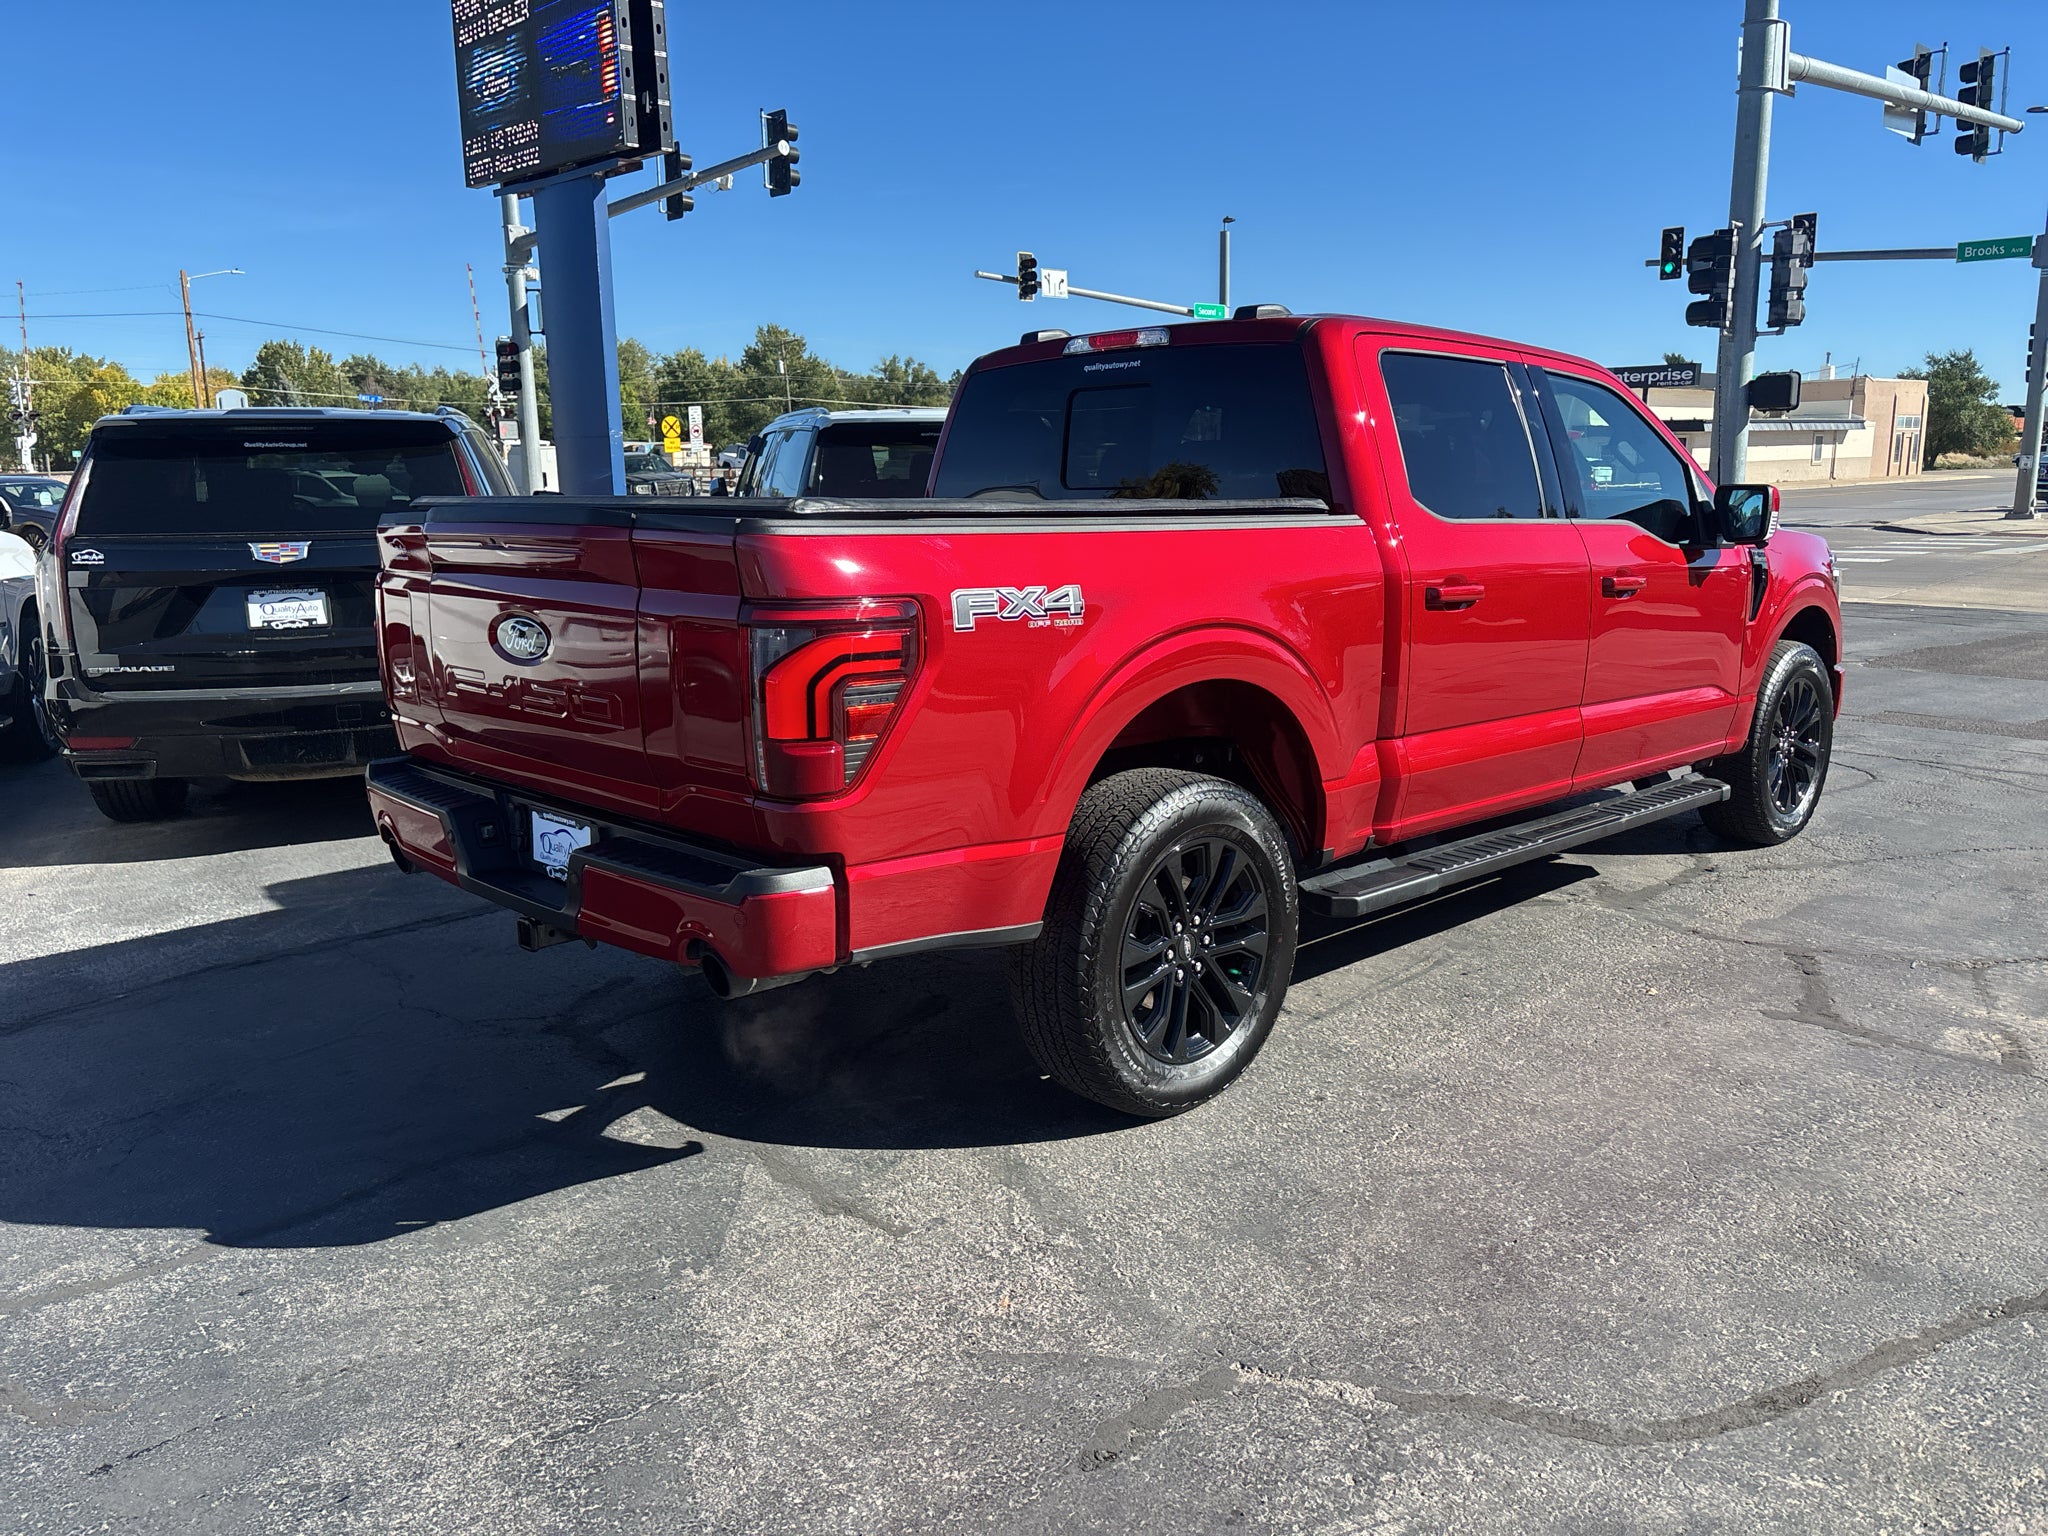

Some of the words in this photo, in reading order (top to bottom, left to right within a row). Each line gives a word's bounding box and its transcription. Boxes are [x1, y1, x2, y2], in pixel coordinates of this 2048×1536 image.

[1964, 244, 2005, 258] Brooks
[1083, 359, 1141, 373] qualityautowy.net
[1614, 368, 1694, 385] nterprise
[950, 584, 1085, 633] FX4
[505, 623, 537, 653] Ford
[87, 665, 176, 674] ESCALADE
